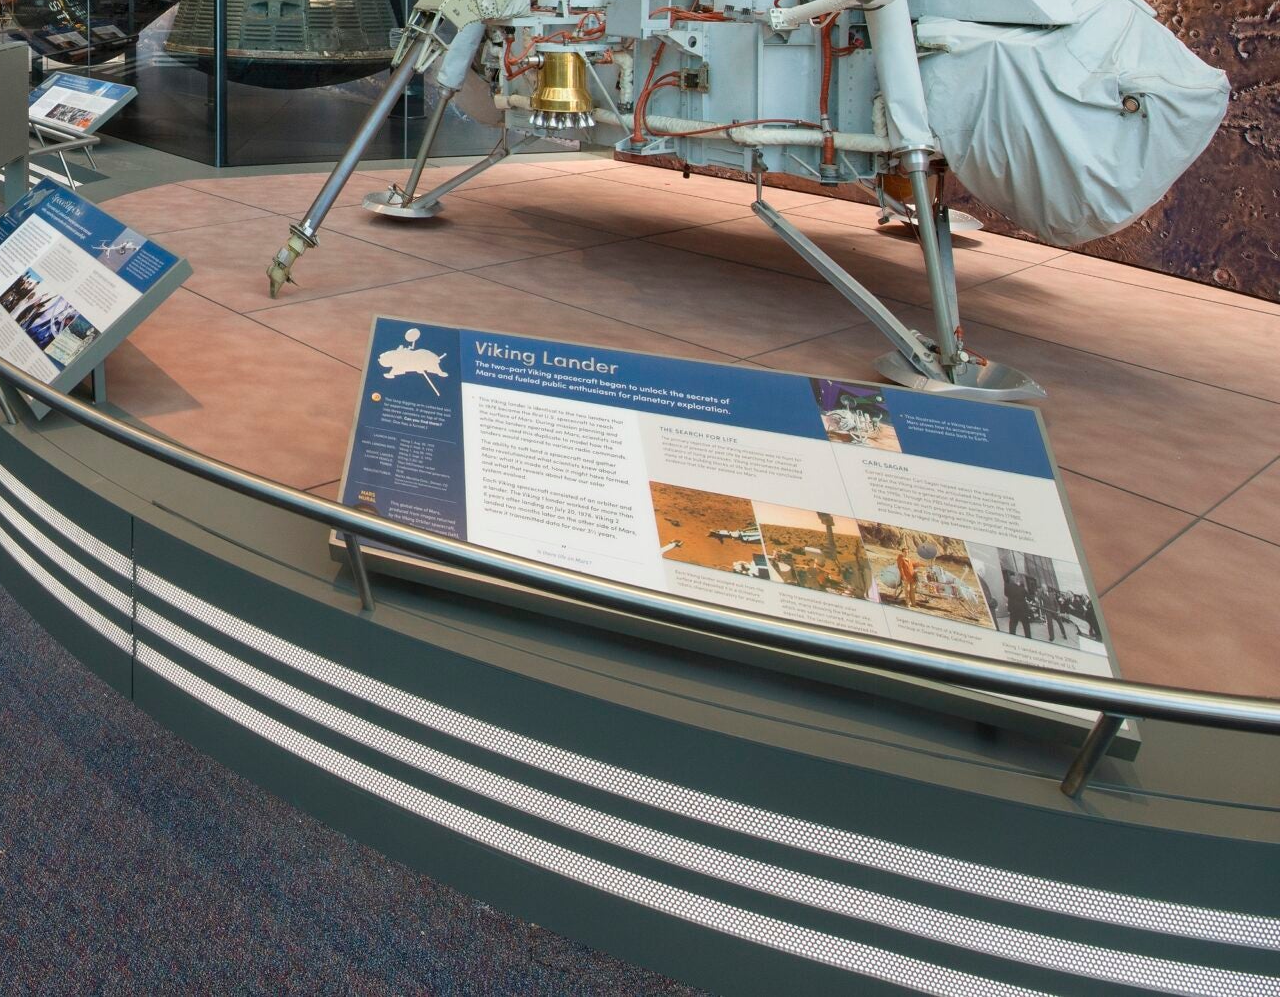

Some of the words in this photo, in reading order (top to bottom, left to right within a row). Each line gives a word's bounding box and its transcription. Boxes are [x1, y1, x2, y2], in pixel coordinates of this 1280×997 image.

[474, 340, 536, 366] Viking
[541, 350, 618, 376] Lander
[475, 359, 489, 368] The
[490, 361, 526, 375] two-part
[527, 367, 551, 379] Viking
[553, 371, 597, 386] spacecraft
[599, 378, 626, 390] began
[628, 382, 637, 391] to
[639, 384, 667, 396] unlock
[669, 389, 683, 398] the
[686, 391, 718, 404] secrets
[720, 397, 729, 405] of
[475, 367, 496, 377] Mars
[497, 371, 513, 380] and
[515, 374, 540, 384] fueled
[541, 378, 566, 390] public
[568, 382, 616, 397] enthusiasm
[618, 390, 630, 399] for
[633, 392, 674, 407] planetary
[677, 399, 730, 416] exploration.
[660, 424, 673, 433] THE
[675, 426, 703, 438] SEARCH
[704, 431, 720, 440] FOR
[722, 434, 737, 443] LIFE
[862, 456, 882, 467] CARL
[882, 460, 909, 472] SAGAN
